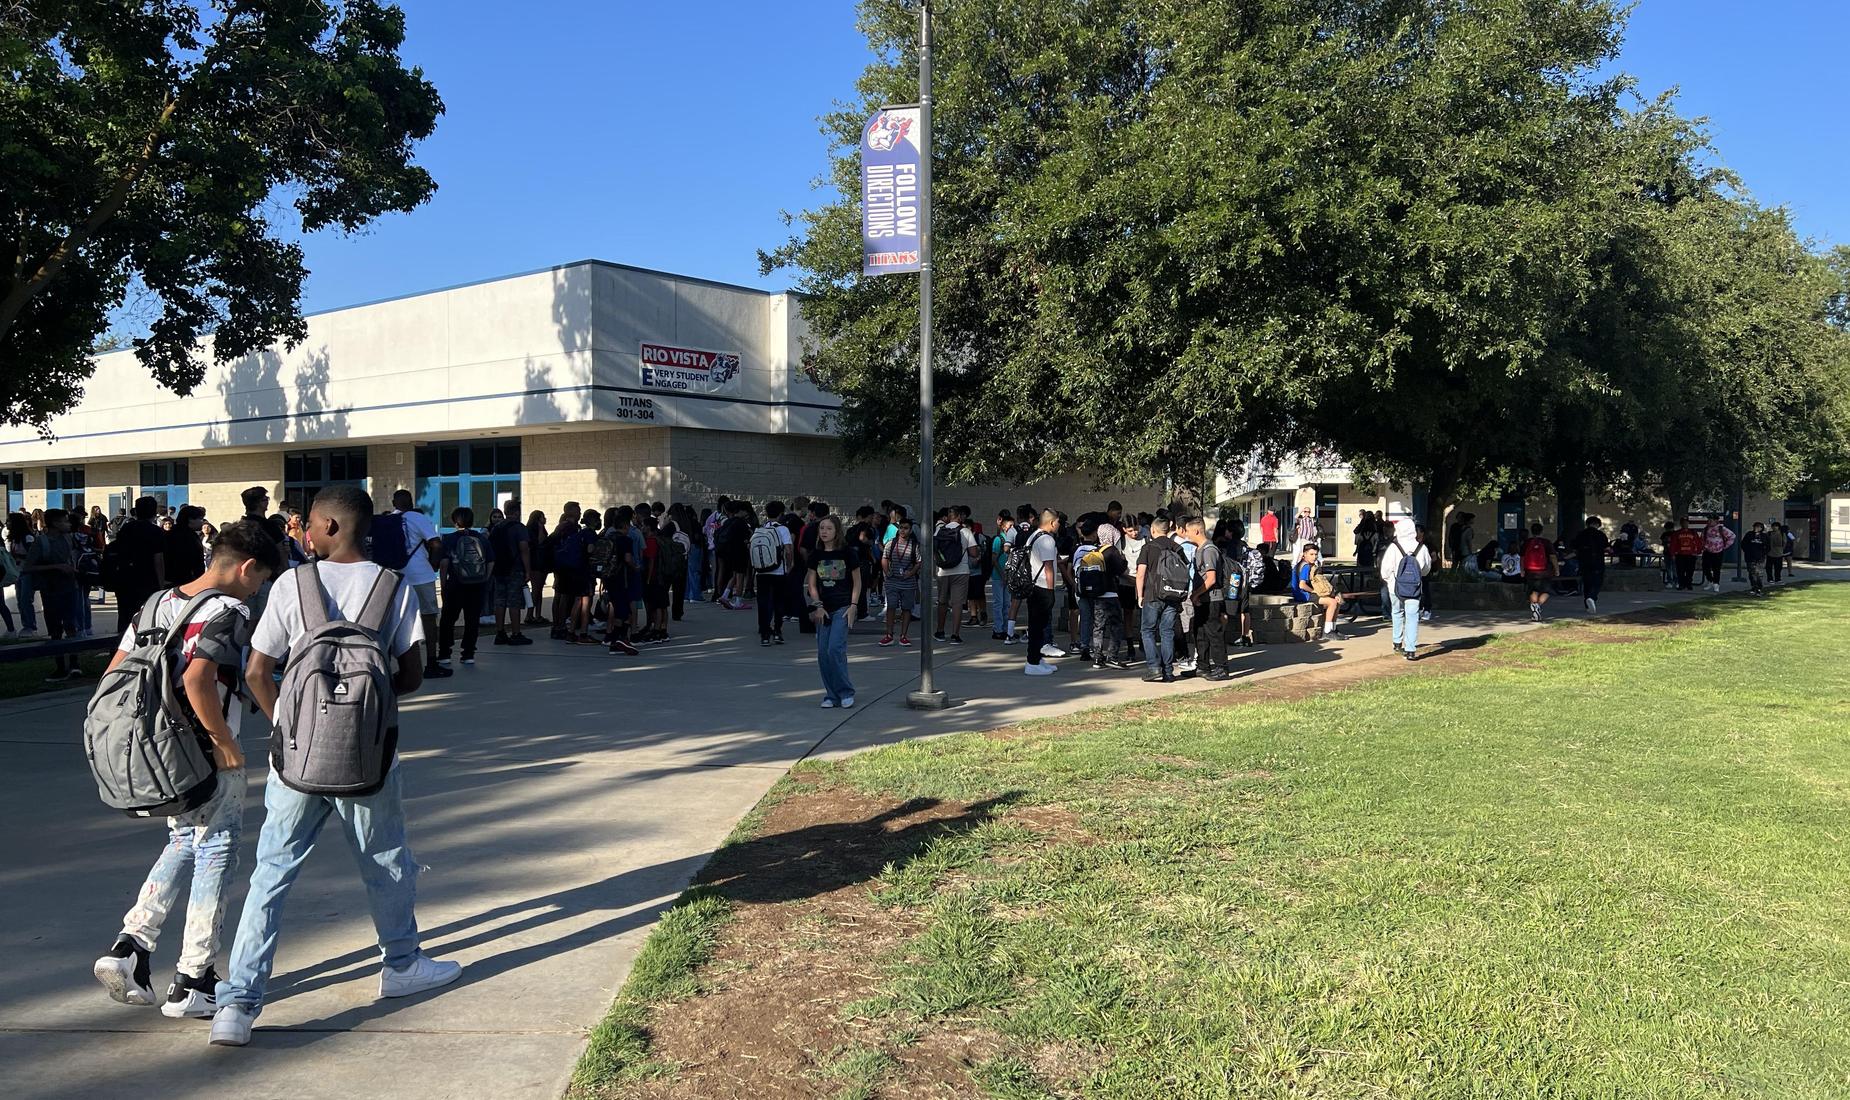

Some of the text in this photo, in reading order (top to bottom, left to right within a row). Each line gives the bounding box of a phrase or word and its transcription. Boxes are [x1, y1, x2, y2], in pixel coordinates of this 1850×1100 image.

[866, 164, 895, 238] DIRECTIONS
[896, 163, 917, 237] FOLLOW
[867, 250, 919, 267] TITANS
[643, 347, 709, 368] RIO VISTA
[676, 371, 710, 382] STUDENT
[618, 396, 653, 408] TITANS
[616, 407, 654, 420] 301-304
